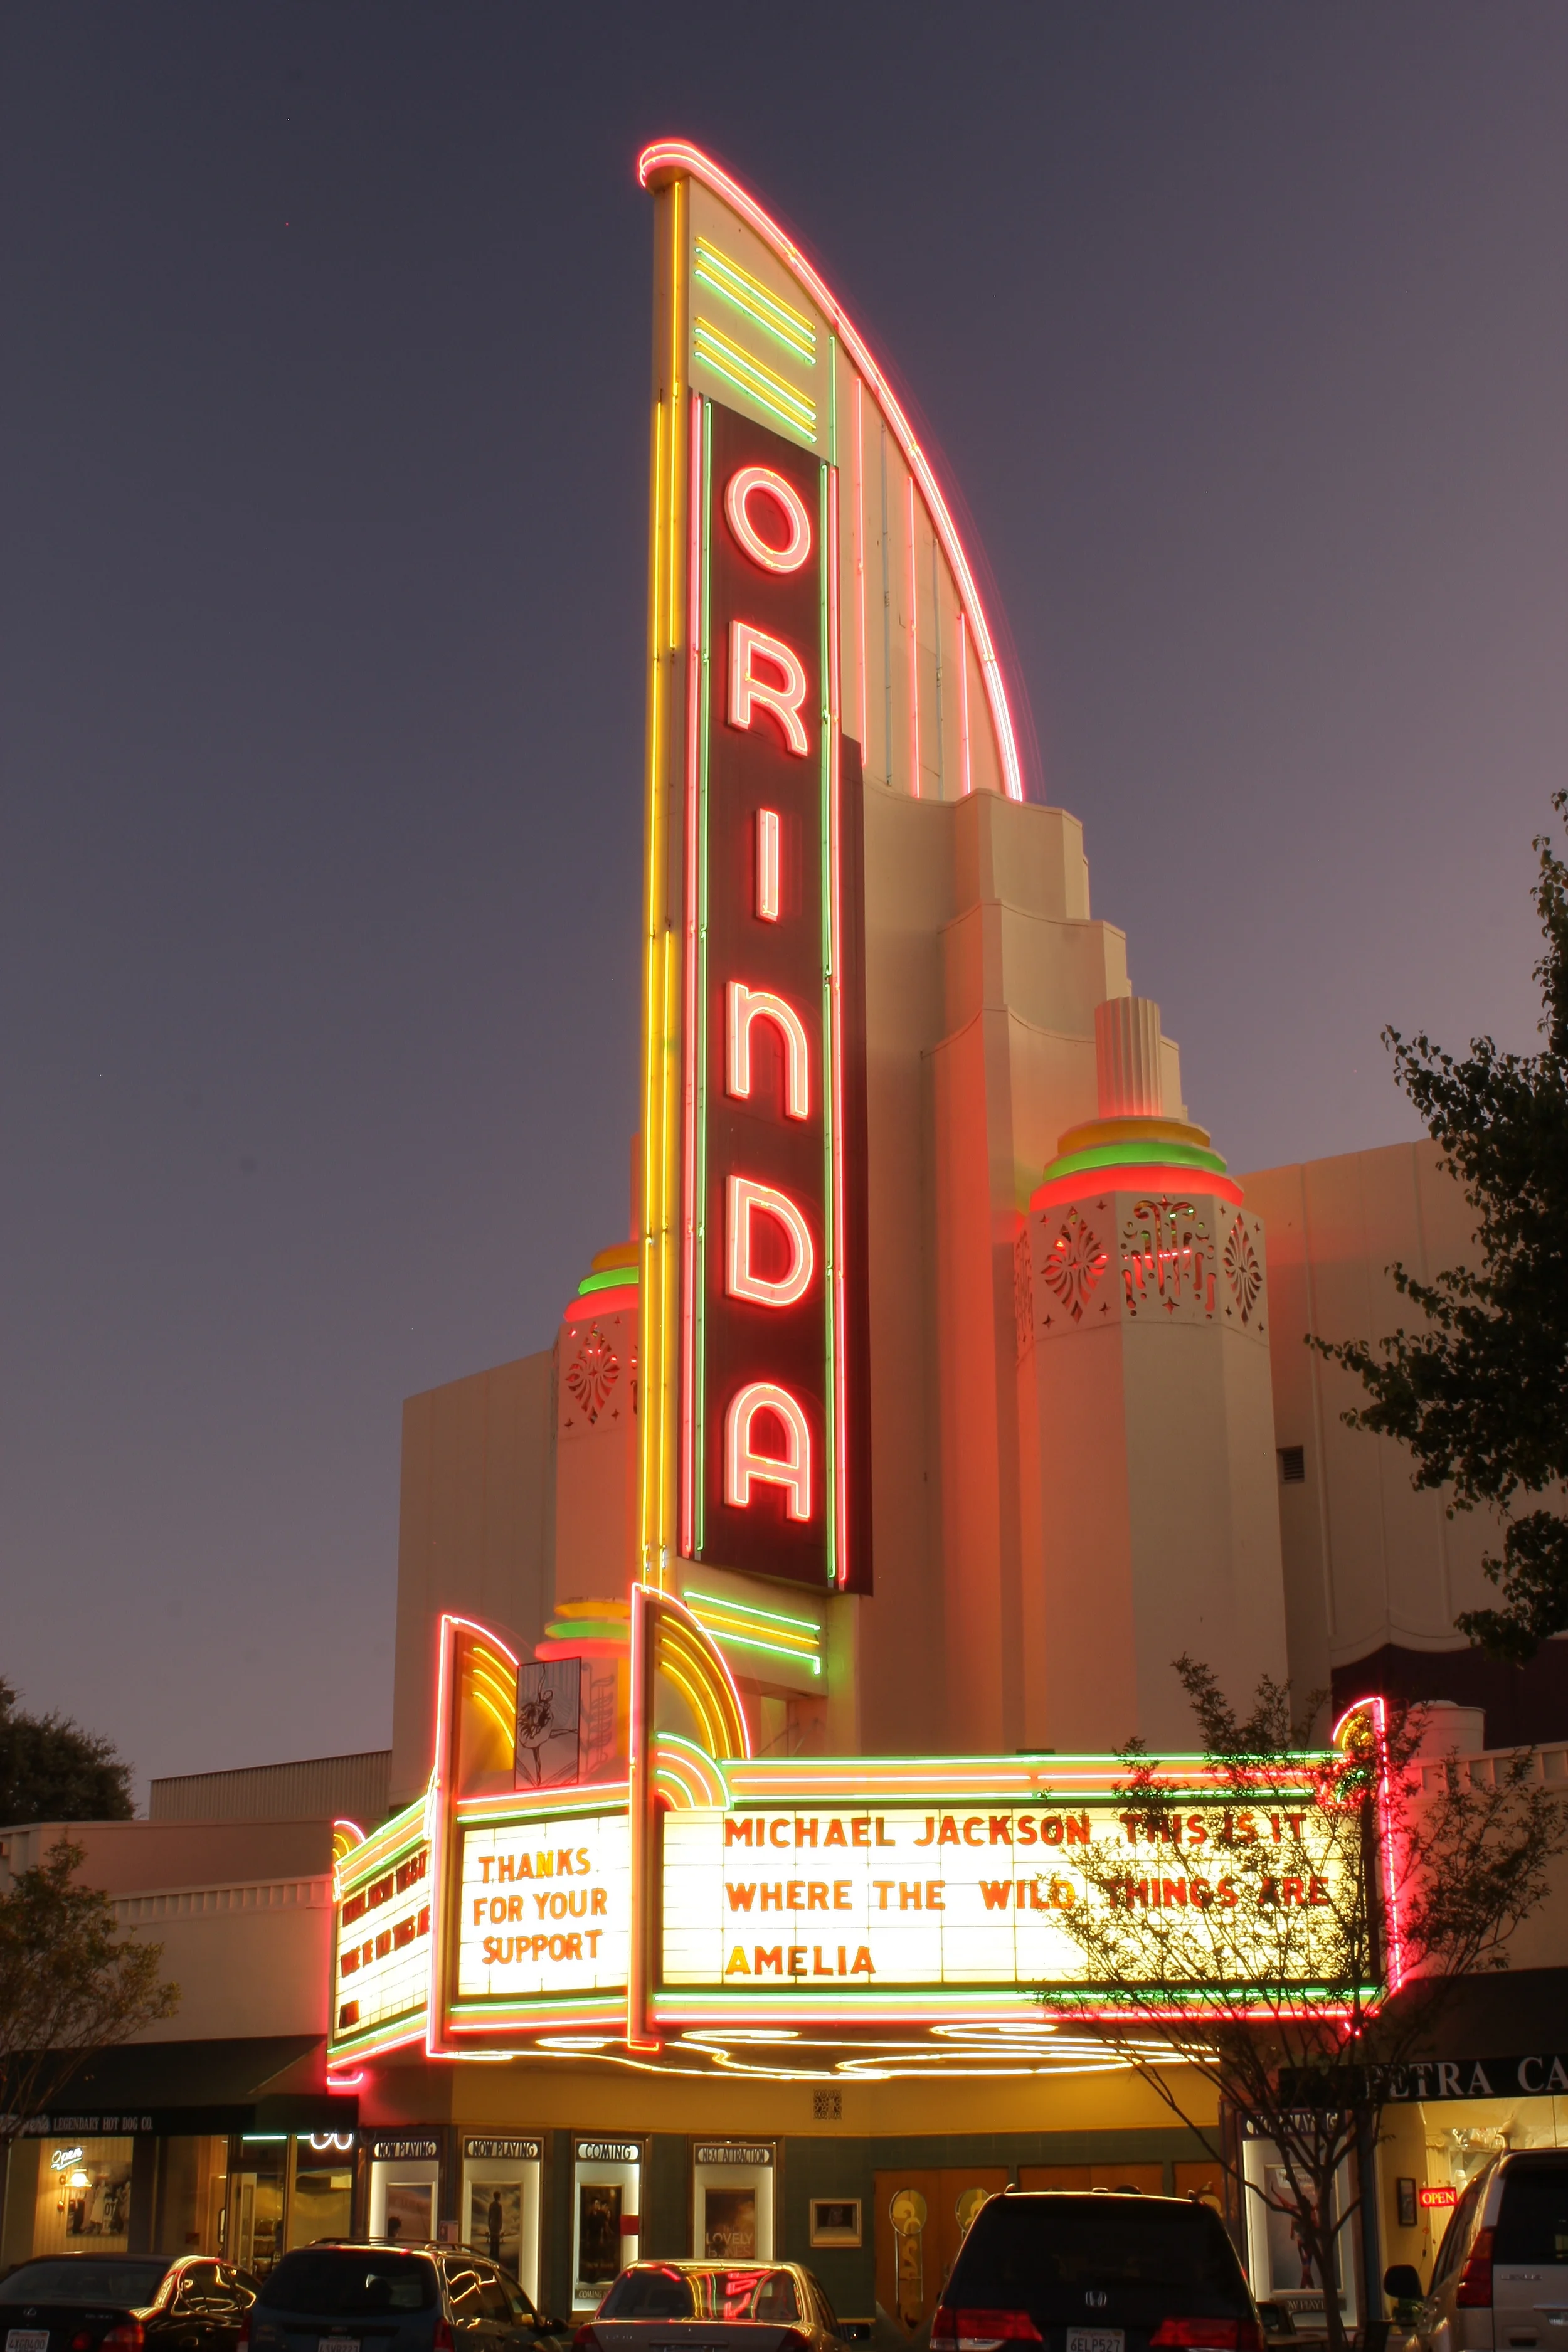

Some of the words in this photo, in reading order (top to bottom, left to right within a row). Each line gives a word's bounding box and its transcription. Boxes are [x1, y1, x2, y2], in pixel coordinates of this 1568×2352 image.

[724, 467, 813, 1522] ORINDA
[725, 1816, 895, 1848] MICHAEL
[914, 1814, 1090, 1846] JACKSON
[1120, 1813, 1207, 1844] THIS
[1223, 1813, 1257, 1845] IS
[1271, 1813, 1306, 1843] IT
[478, 1847, 591, 1883] THANKS
[725, 1880, 852, 1912] WHERE
[873, 1880, 946, 1910] THE
[980, 1879, 1075, 1910] WILD
[1099, 1877, 1238, 1909] THINGS
[1257, 1876, 1329, 1907] ARE
[474, 1897, 523, 1926] FOR
[533, 1888, 607, 1920] YOUR
[482, 1929, 603, 1964] SUPPORT
[725, 1946, 875, 1976] AMELIA
[53, 2117, 99, 2131] LEGENDARY
[103, 2117, 120, 2131] HOT
[122, 2117, 138, 2131] DOG
[51, 2146, 83, 2164] Open
[379, 2141, 396, 2157] NOW
[399, 2141, 434, 2157] PLAYING
[474, 2141, 494, 2157] NOW
[496, 2141, 536, 2157] PLAYING
[585, 2144, 632, 2159] COMING
[702, 2148, 719, 2163] NEXT
[723, 2148, 765, 2163] ATTRACTION
[1422, 2191, 1454, 2205] OPEN
[706, 2232, 753, 2245] LOVELY
[1070, 2337, 1120, 2352] 6ELP527
